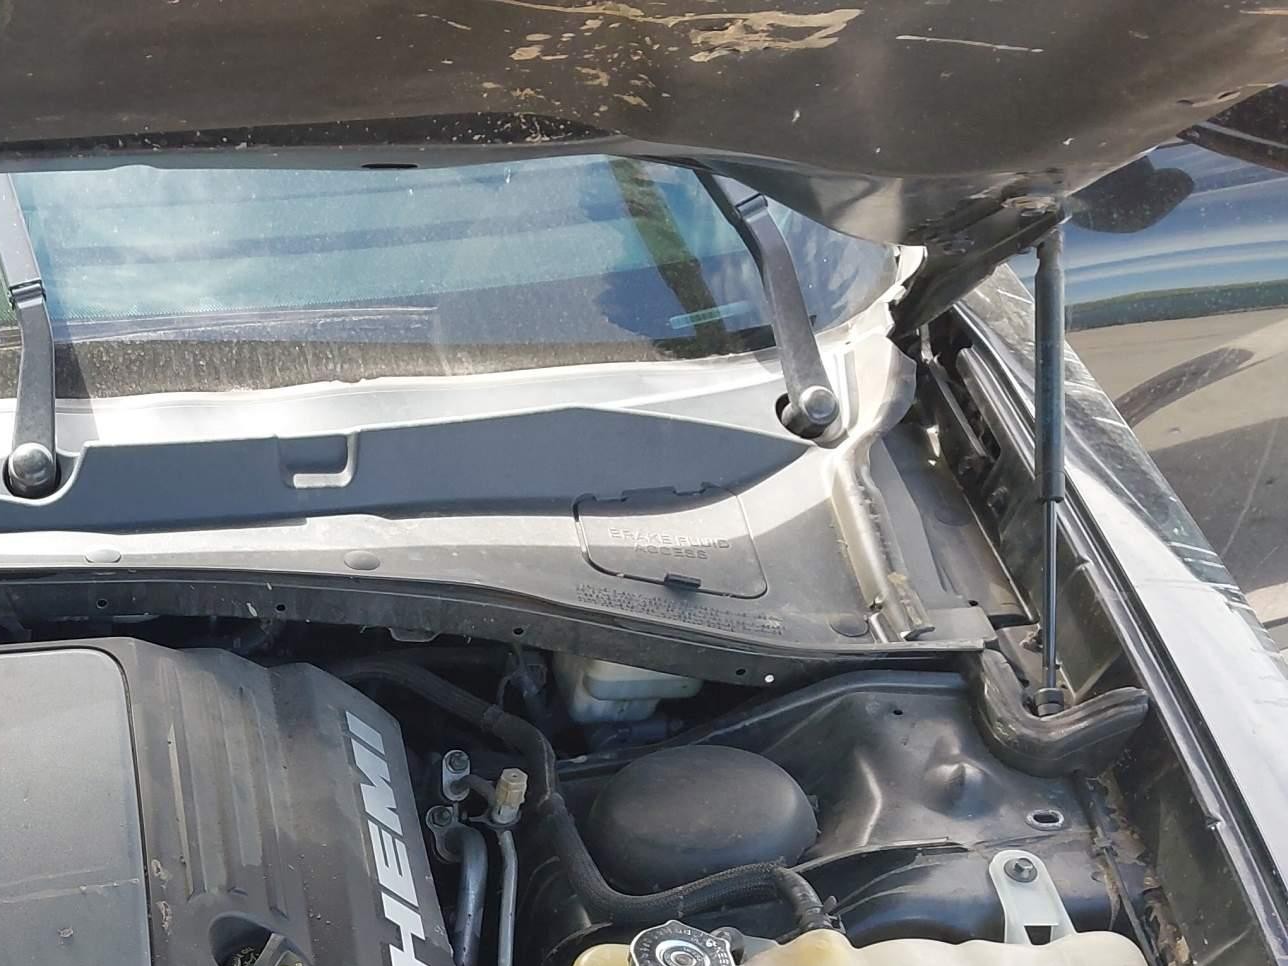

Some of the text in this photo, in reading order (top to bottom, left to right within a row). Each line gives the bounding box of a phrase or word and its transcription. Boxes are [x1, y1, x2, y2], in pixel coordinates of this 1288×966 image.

[608, 527, 731, 550] BRAKE FLUID
[635, 545, 708, 560] ACCESS
